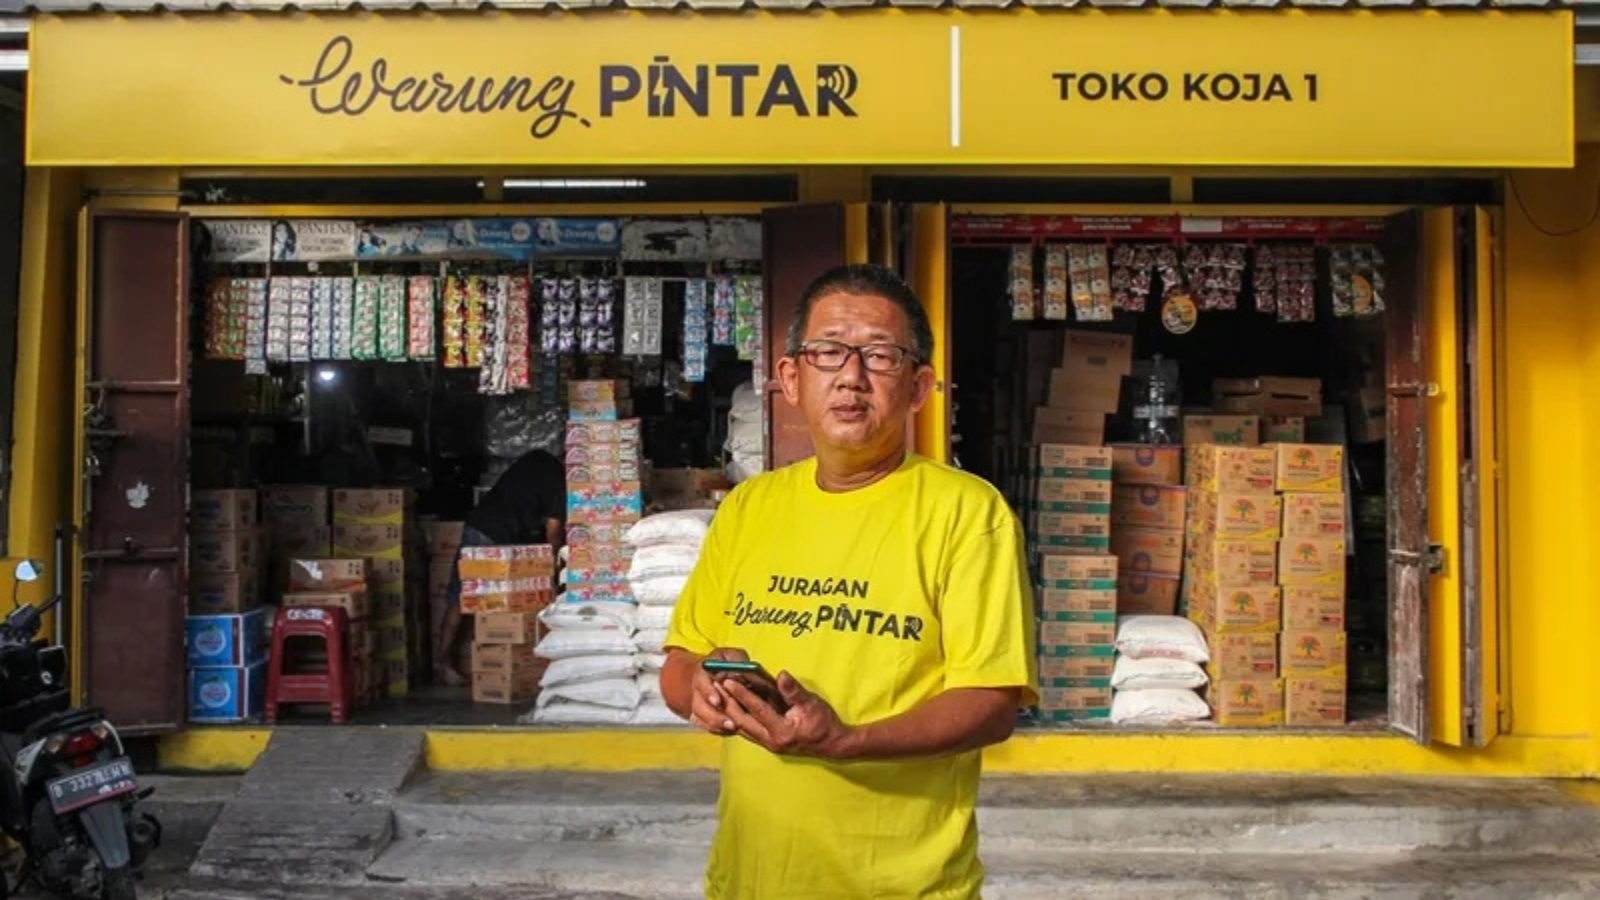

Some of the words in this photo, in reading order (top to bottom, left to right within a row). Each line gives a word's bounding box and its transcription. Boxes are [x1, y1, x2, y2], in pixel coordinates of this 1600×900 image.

[279, 35, 591, 139] Warung
[600, 55, 858, 117] PINTAR
[1052, 73, 1169, 101] TOKO
[1183, 73, 1293, 102] KOJA
[1304, 74, 1318, 102] 1
[213, 222, 267, 235] PANTENE
[297, 222, 351, 235] PANTENE
[767, 575, 869, 598] JURAGAN
[724, 592, 813, 638] Warung
[815, 604, 924, 641] PINTAR
